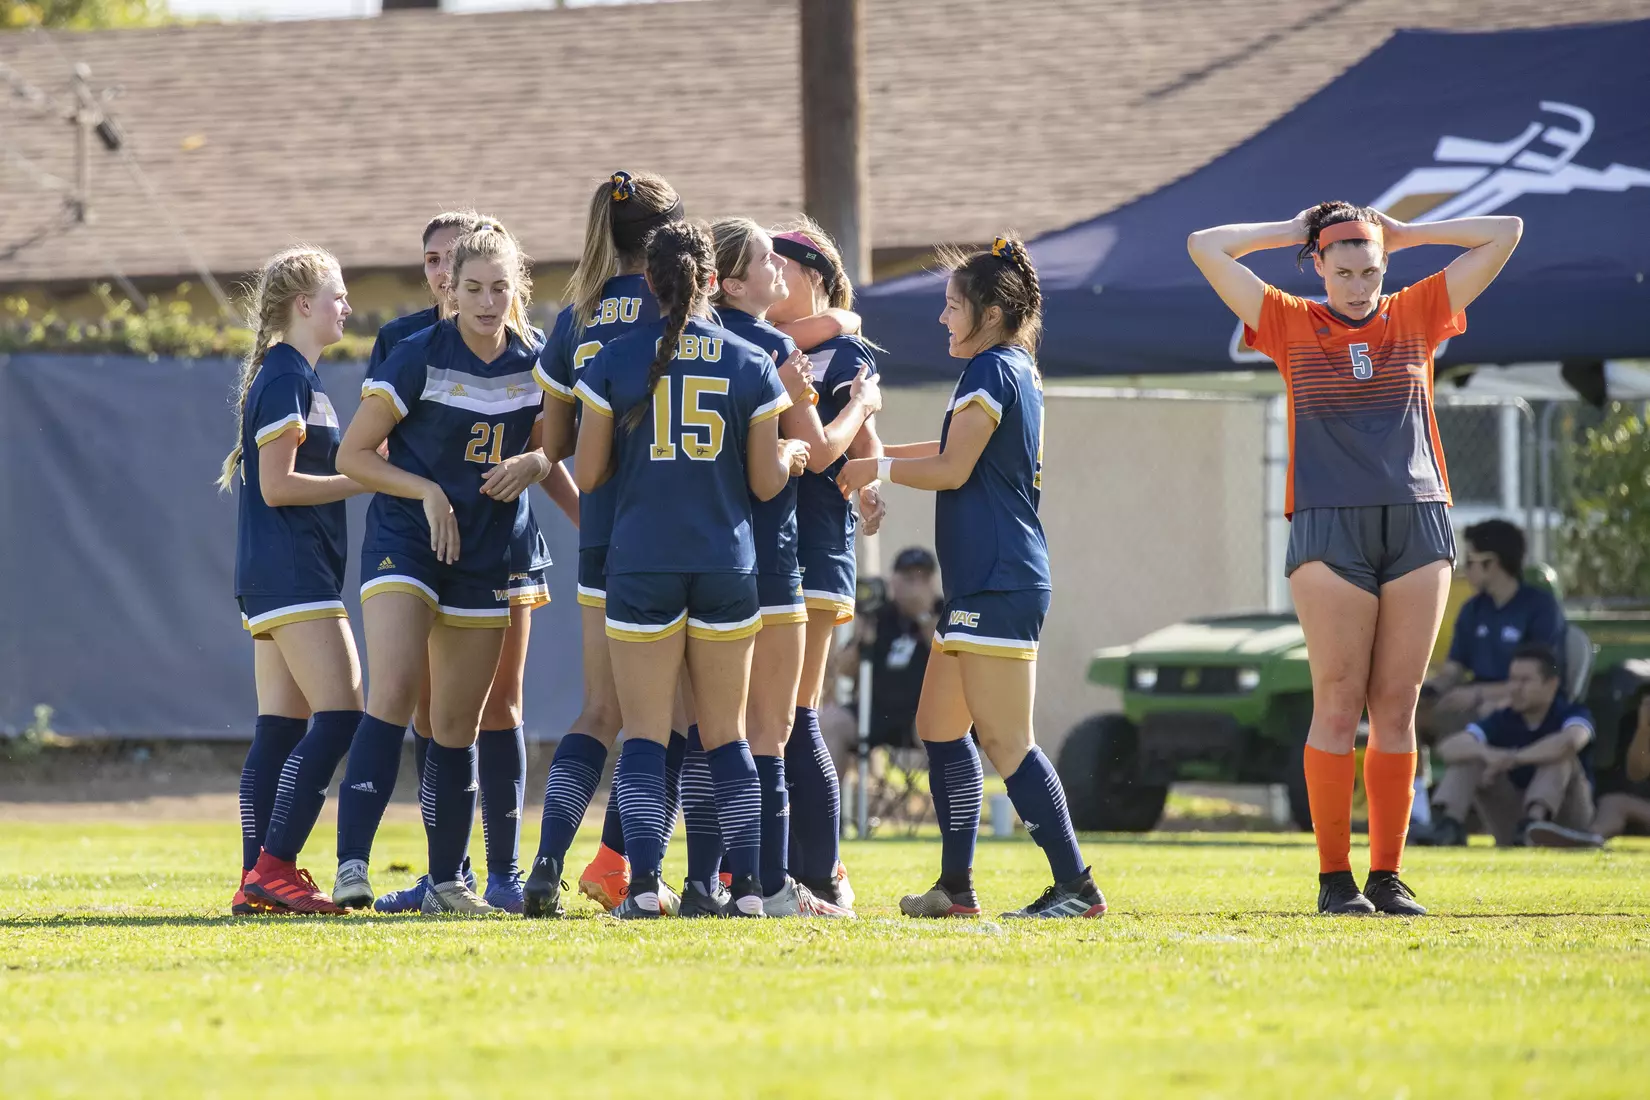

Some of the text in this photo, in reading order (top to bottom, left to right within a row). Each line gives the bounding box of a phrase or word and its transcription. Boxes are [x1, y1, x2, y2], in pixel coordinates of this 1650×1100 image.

[1348, 342, 1373, 379] 5
[650, 375, 730, 461] 15
[464, 421, 505, 464] 21
